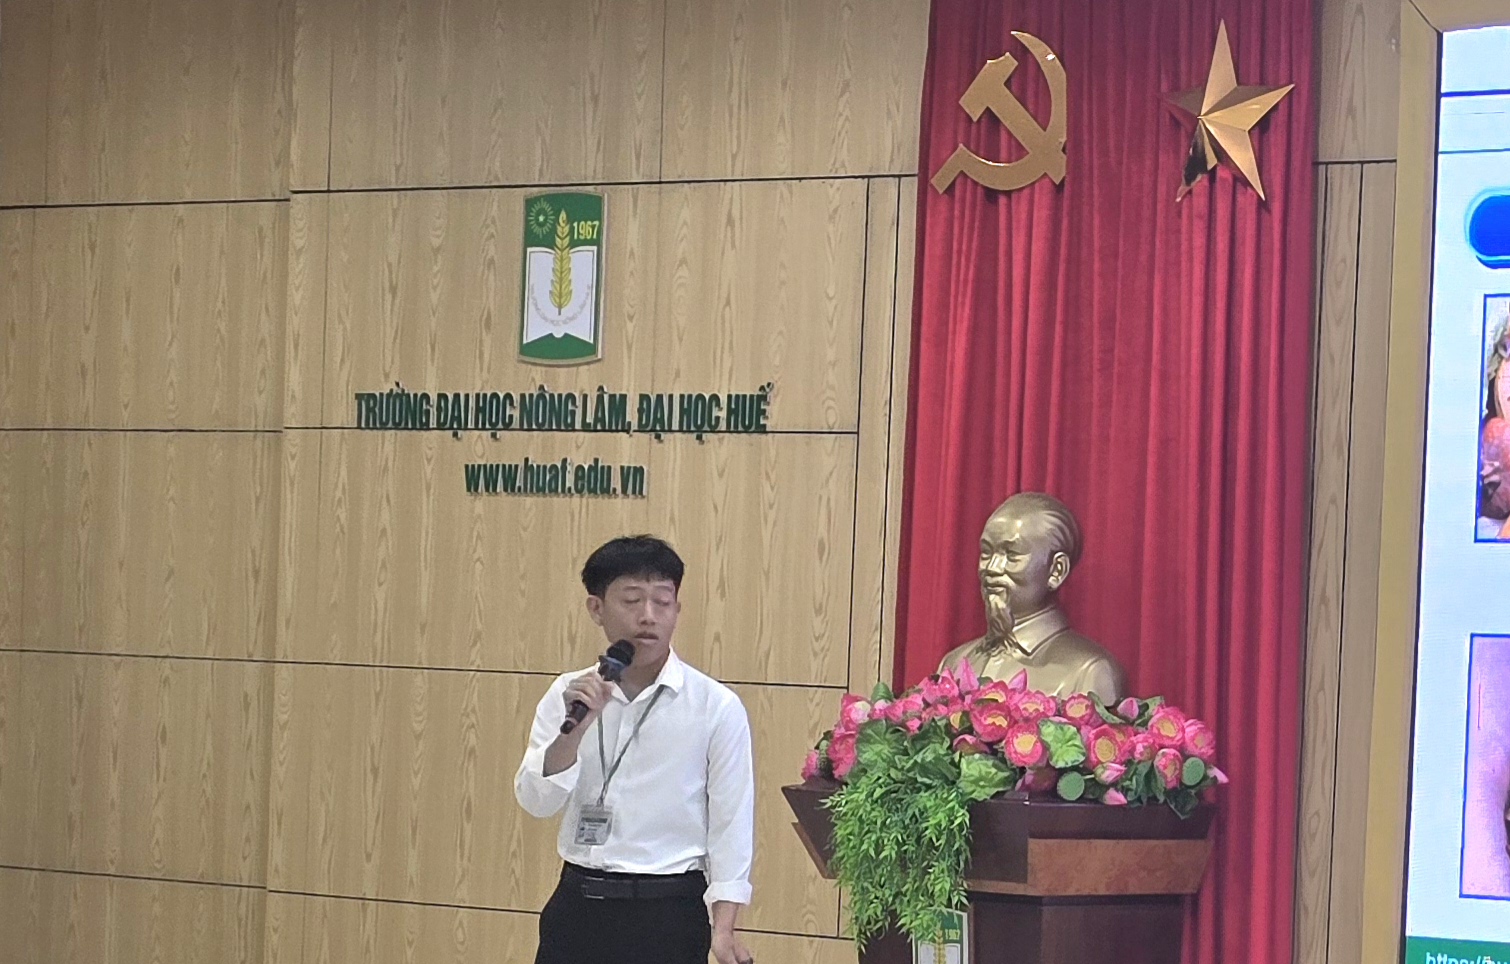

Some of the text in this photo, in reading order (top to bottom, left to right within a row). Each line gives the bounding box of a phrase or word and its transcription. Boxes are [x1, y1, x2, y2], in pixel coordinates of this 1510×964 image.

[573, 221, 599, 239] 1967
[355, 381, 774, 444] TRƯỜNG ĐẠI HỌC NÔNG LÂM, ĐẠI HỌC HUẾ
[464, 456, 646, 497] www.huaf.edu.vn
